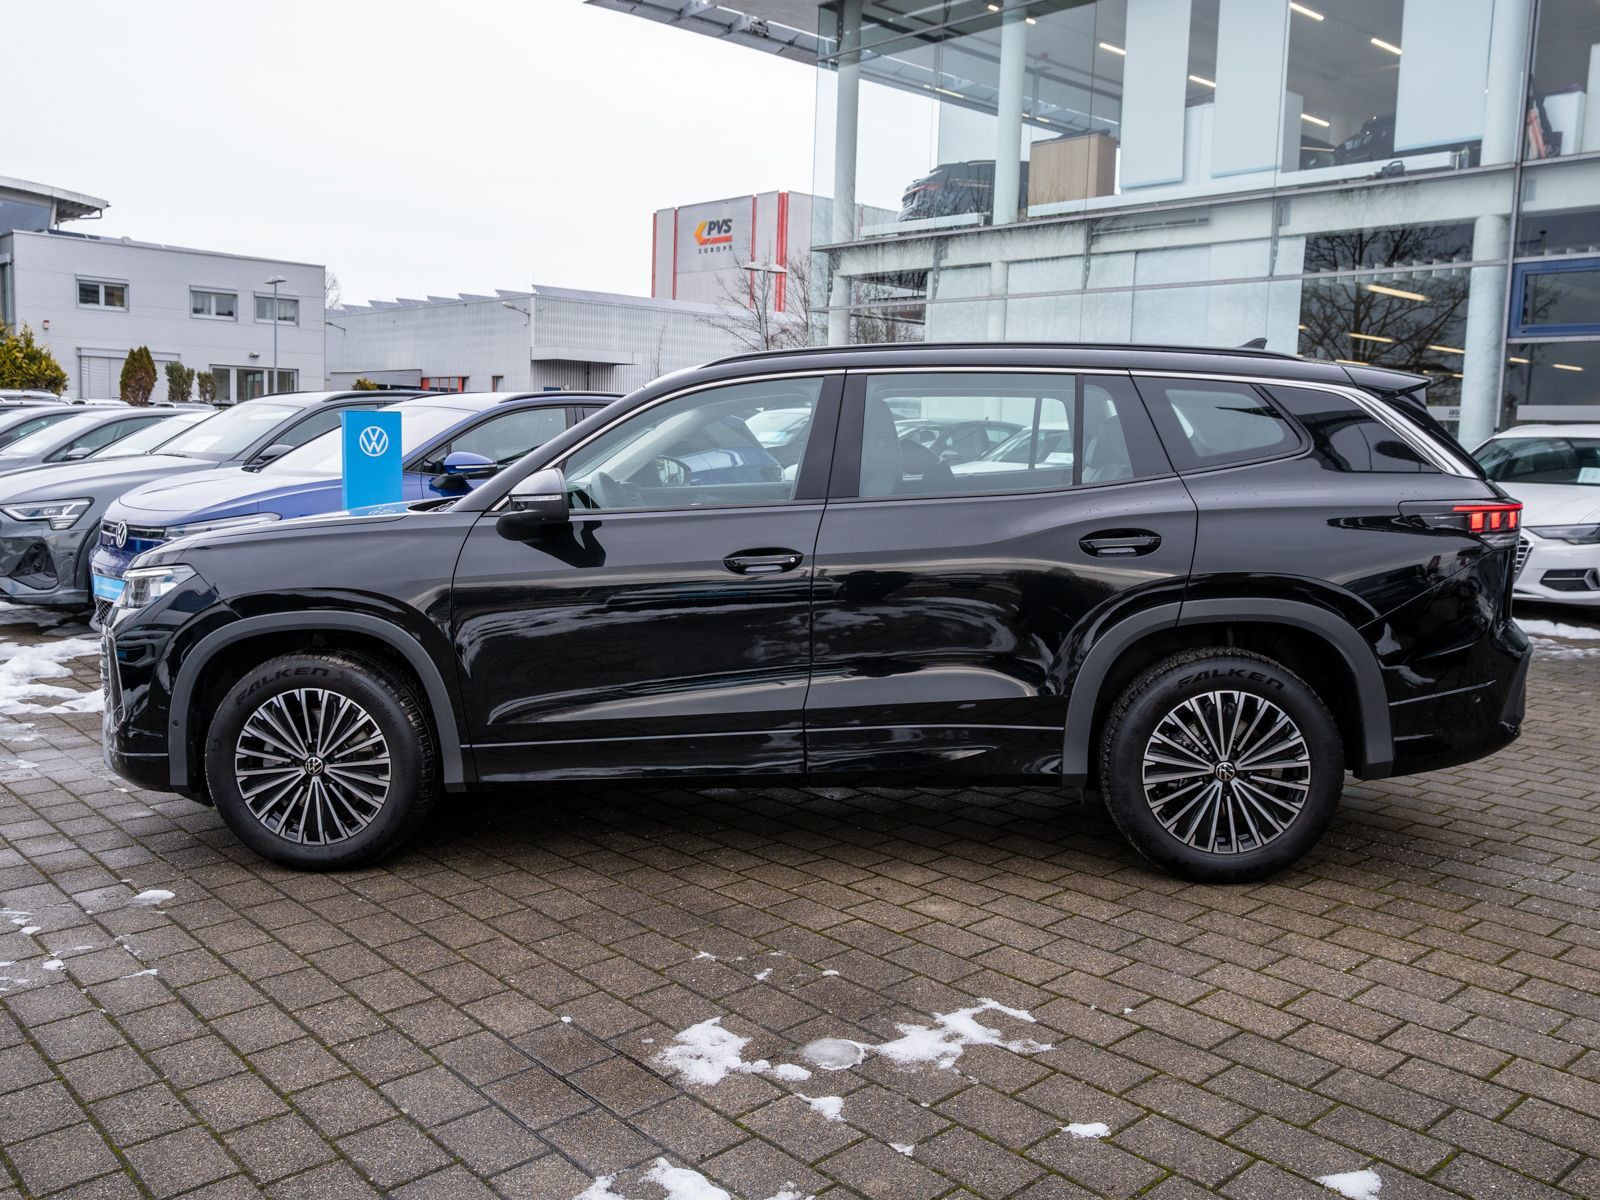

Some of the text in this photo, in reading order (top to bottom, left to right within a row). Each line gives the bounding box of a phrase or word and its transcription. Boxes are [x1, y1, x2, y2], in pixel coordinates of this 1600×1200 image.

[707, 218, 733, 236] PVS
[236, 666, 329, 706] FALKEN
[1176, 667, 1286, 691] FALKEN
